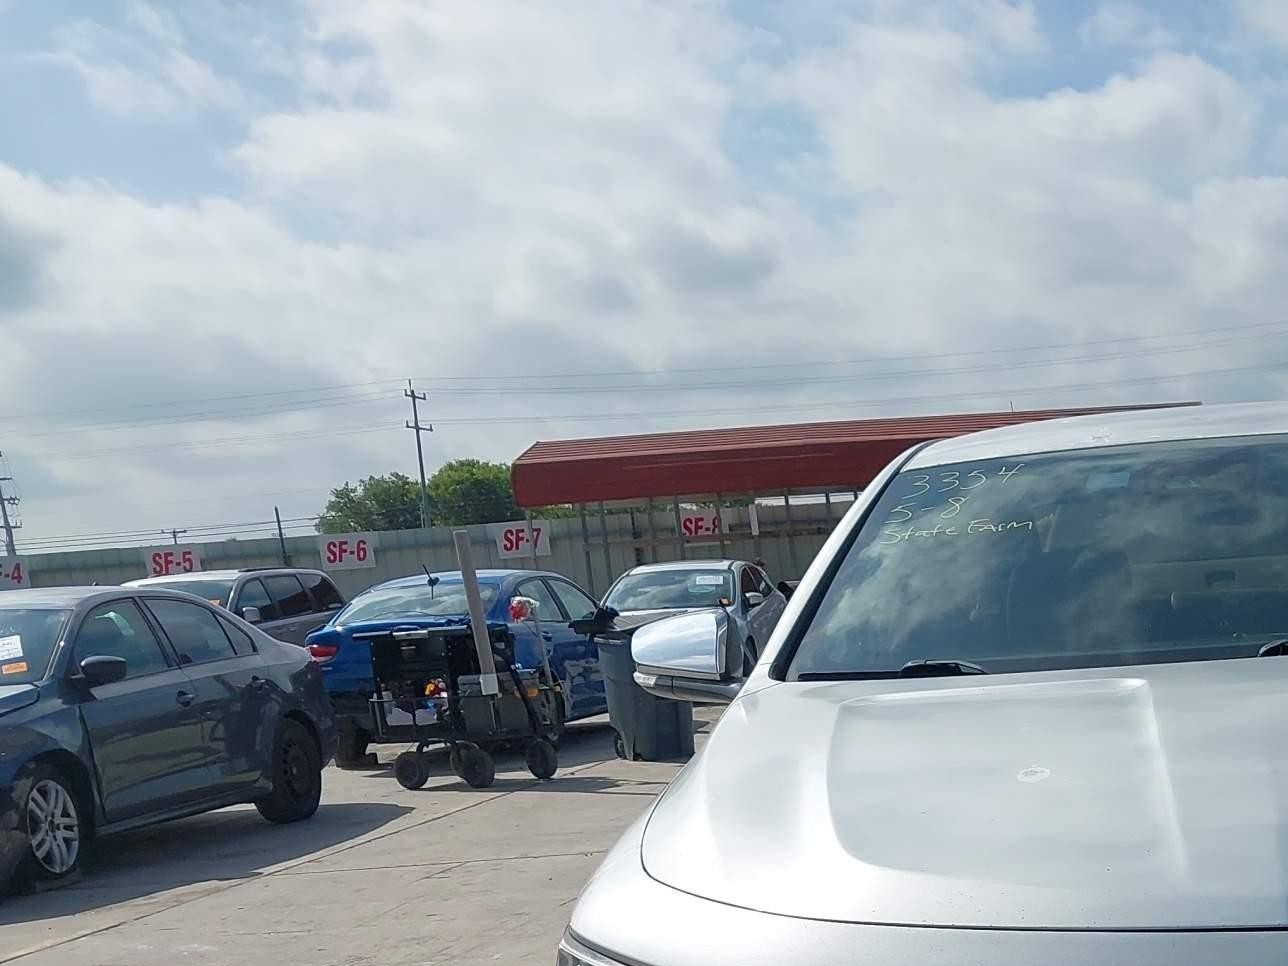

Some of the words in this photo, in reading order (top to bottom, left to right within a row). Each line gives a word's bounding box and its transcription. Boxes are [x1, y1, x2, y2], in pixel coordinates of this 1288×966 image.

[901, 463, 1026, 500] 3354
[883, 496, 970, 524] 5-8
[503, 527, 542, 552] SF-7
[879, 524, 959, 545] State
[152, 550, 193, 575] SF-5
[326, 539, 367, 564] SF-6
